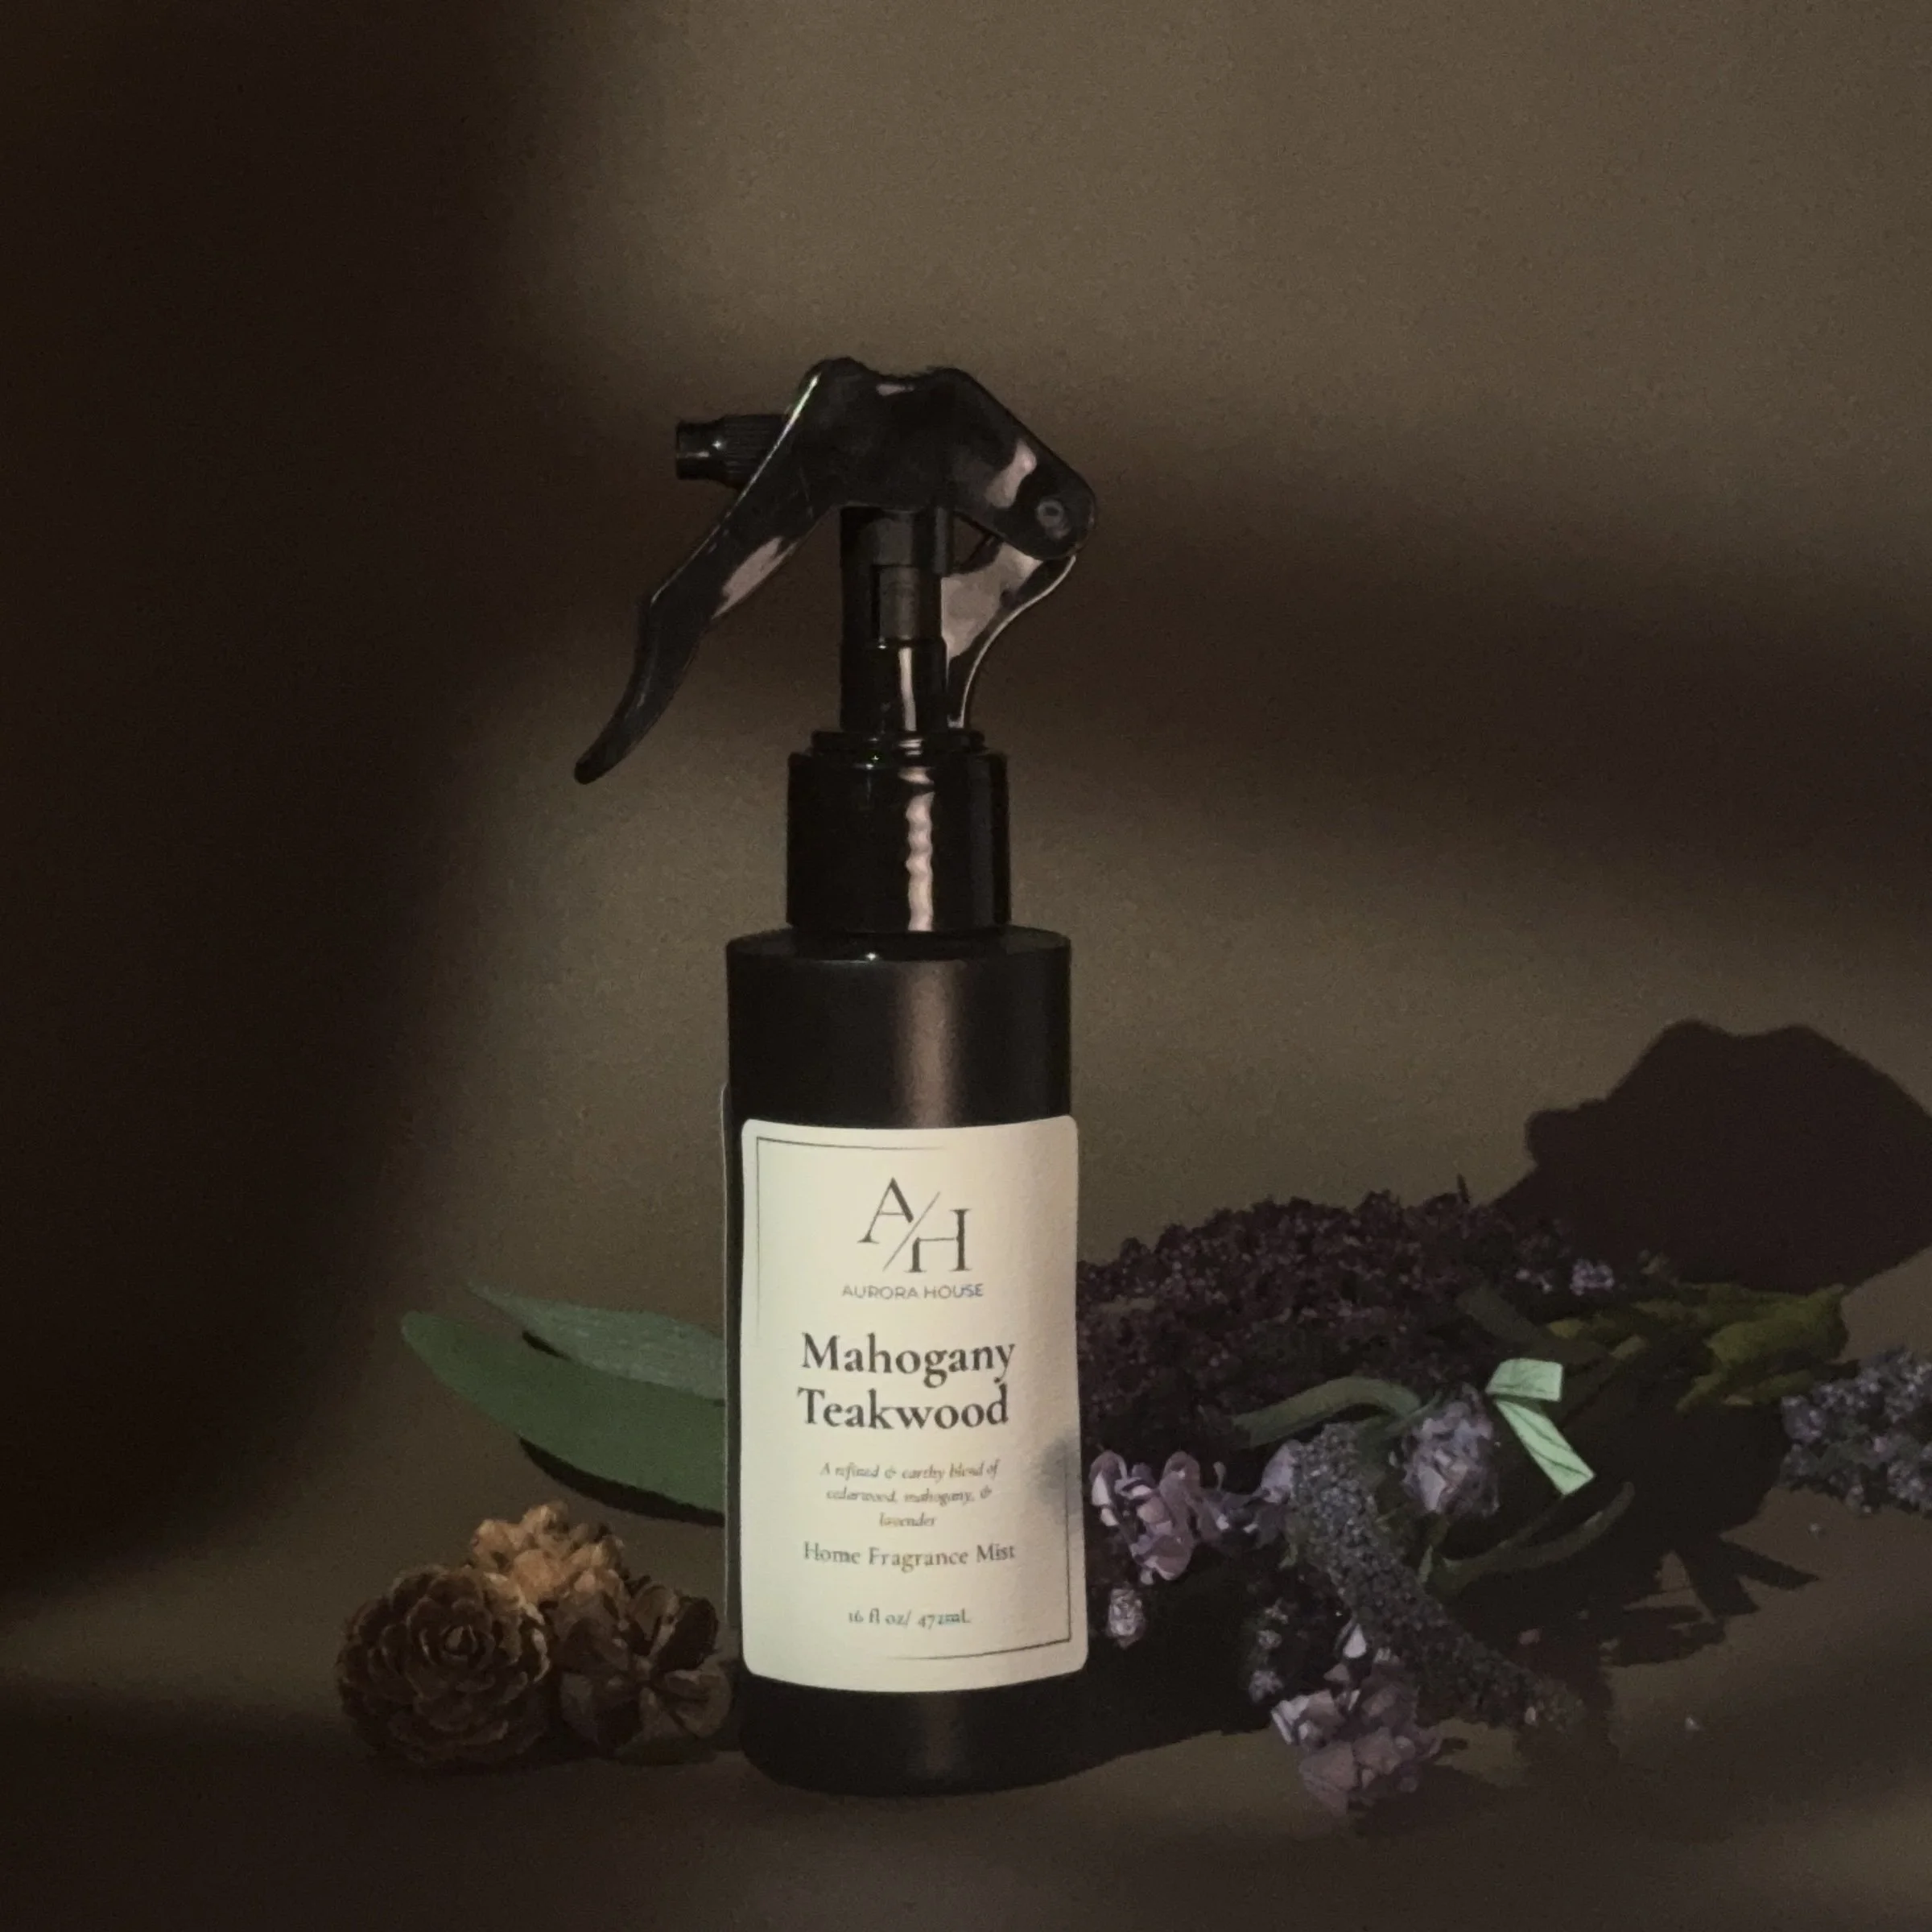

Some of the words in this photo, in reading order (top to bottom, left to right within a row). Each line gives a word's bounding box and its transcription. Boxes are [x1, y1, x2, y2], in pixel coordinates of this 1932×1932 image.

[841, 1285, 919, 1301] AURORA
[923, 1283, 985, 1300] HOUSE
[800, 1331, 1016, 1389] Mahogany
[797, 1382, 1009, 1430] Teakwood
[819, 1462, 831, 1476] A
[986, 1458, 1001, 1480] of
[878, 1512, 936, 1528] lavender
[803, 1541, 861, 1564] Home
[868, 1546, 968, 1573] Fragrance
[976, 1542, 1016, 1563] Mist
[848, 1610, 864, 1624] 16
[869, 1607, 881, 1624] fl
